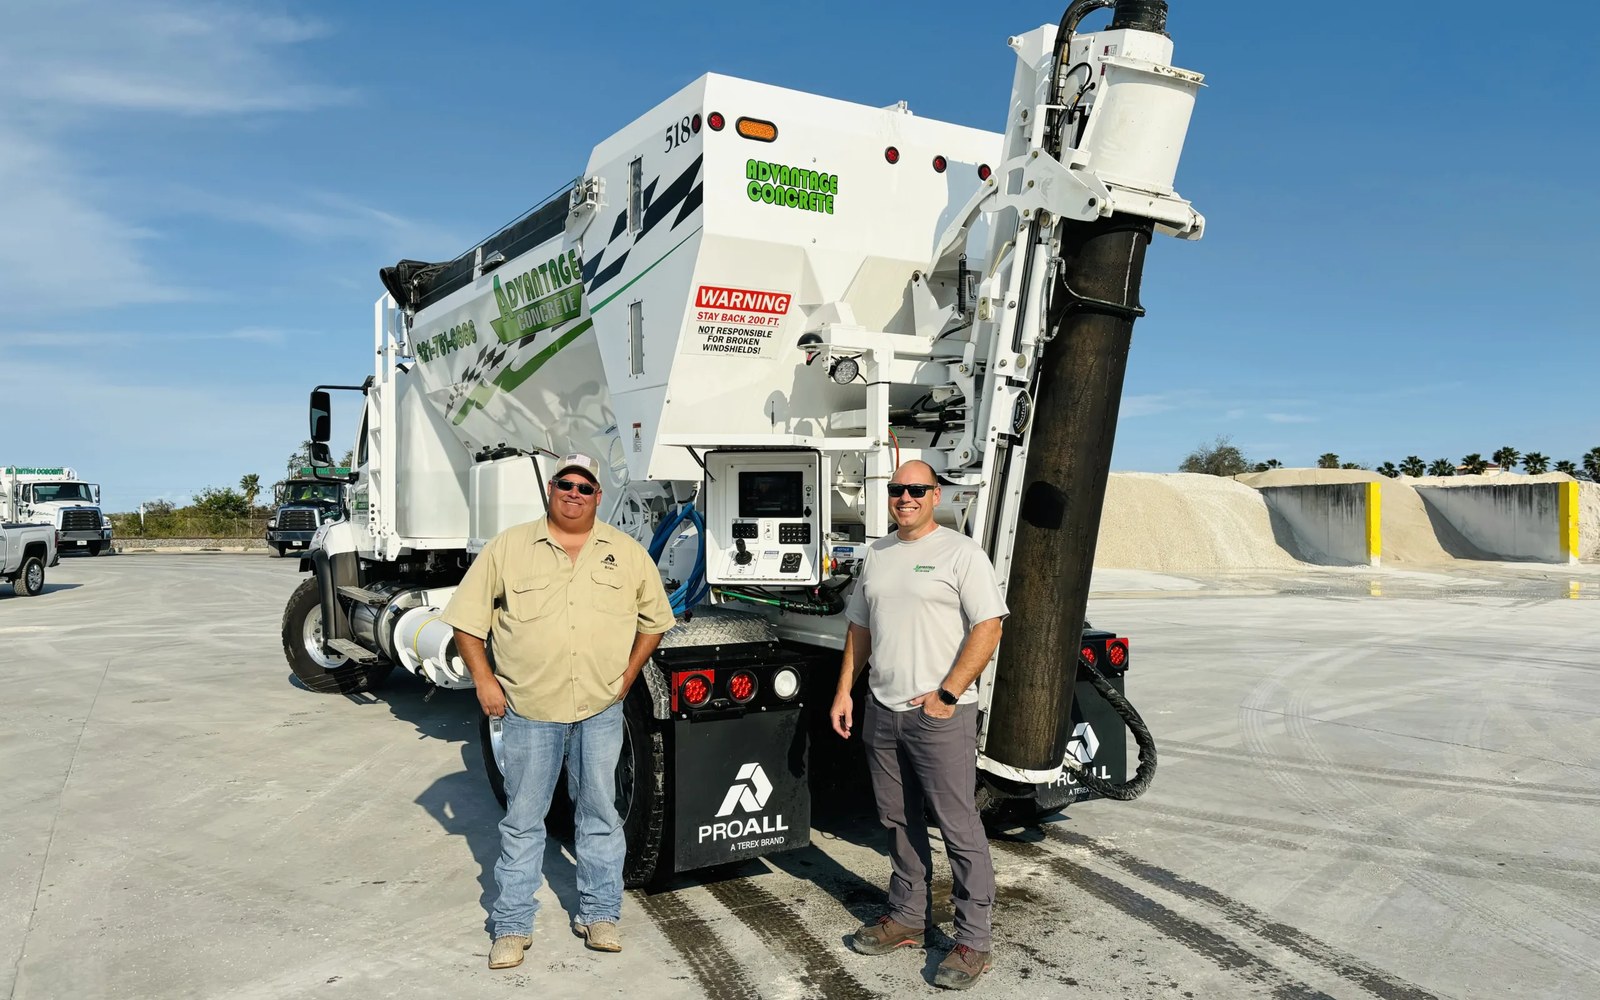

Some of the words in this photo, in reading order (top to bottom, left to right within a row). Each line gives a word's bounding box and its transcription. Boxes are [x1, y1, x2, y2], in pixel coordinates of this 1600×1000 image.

[664, 115, 691, 153] 518
[746, 158, 838, 195] ADVANTAGE
[746, 180, 834, 215] CONCRETE
[493, 248, 581, 323] ADVANTAGE
[516, 291, 577, 331] CONCRETE
[701, 288, 788, 312] WARNING
[697, 311, 719, 321] STAY
[721, 313, 746, 323] BACK
[748, 315, 765, 325] 200
[767, 317, 780, 326] FT.
[698, 325, 715, 334] NOT
[716, 326, 773, 338] RESPONSIBLE
[702, 343, 761, 354] WINDSHIELDS!
[707, 335, 724, 343] FOR
[726, 336, 760, 346] BROKEN
[699, 814, 789, 844] PROALL
[730, 843, 736, 851] A
[737, 840, 760, 850] TEREX
[761, 836, 785, 846] BRAND
